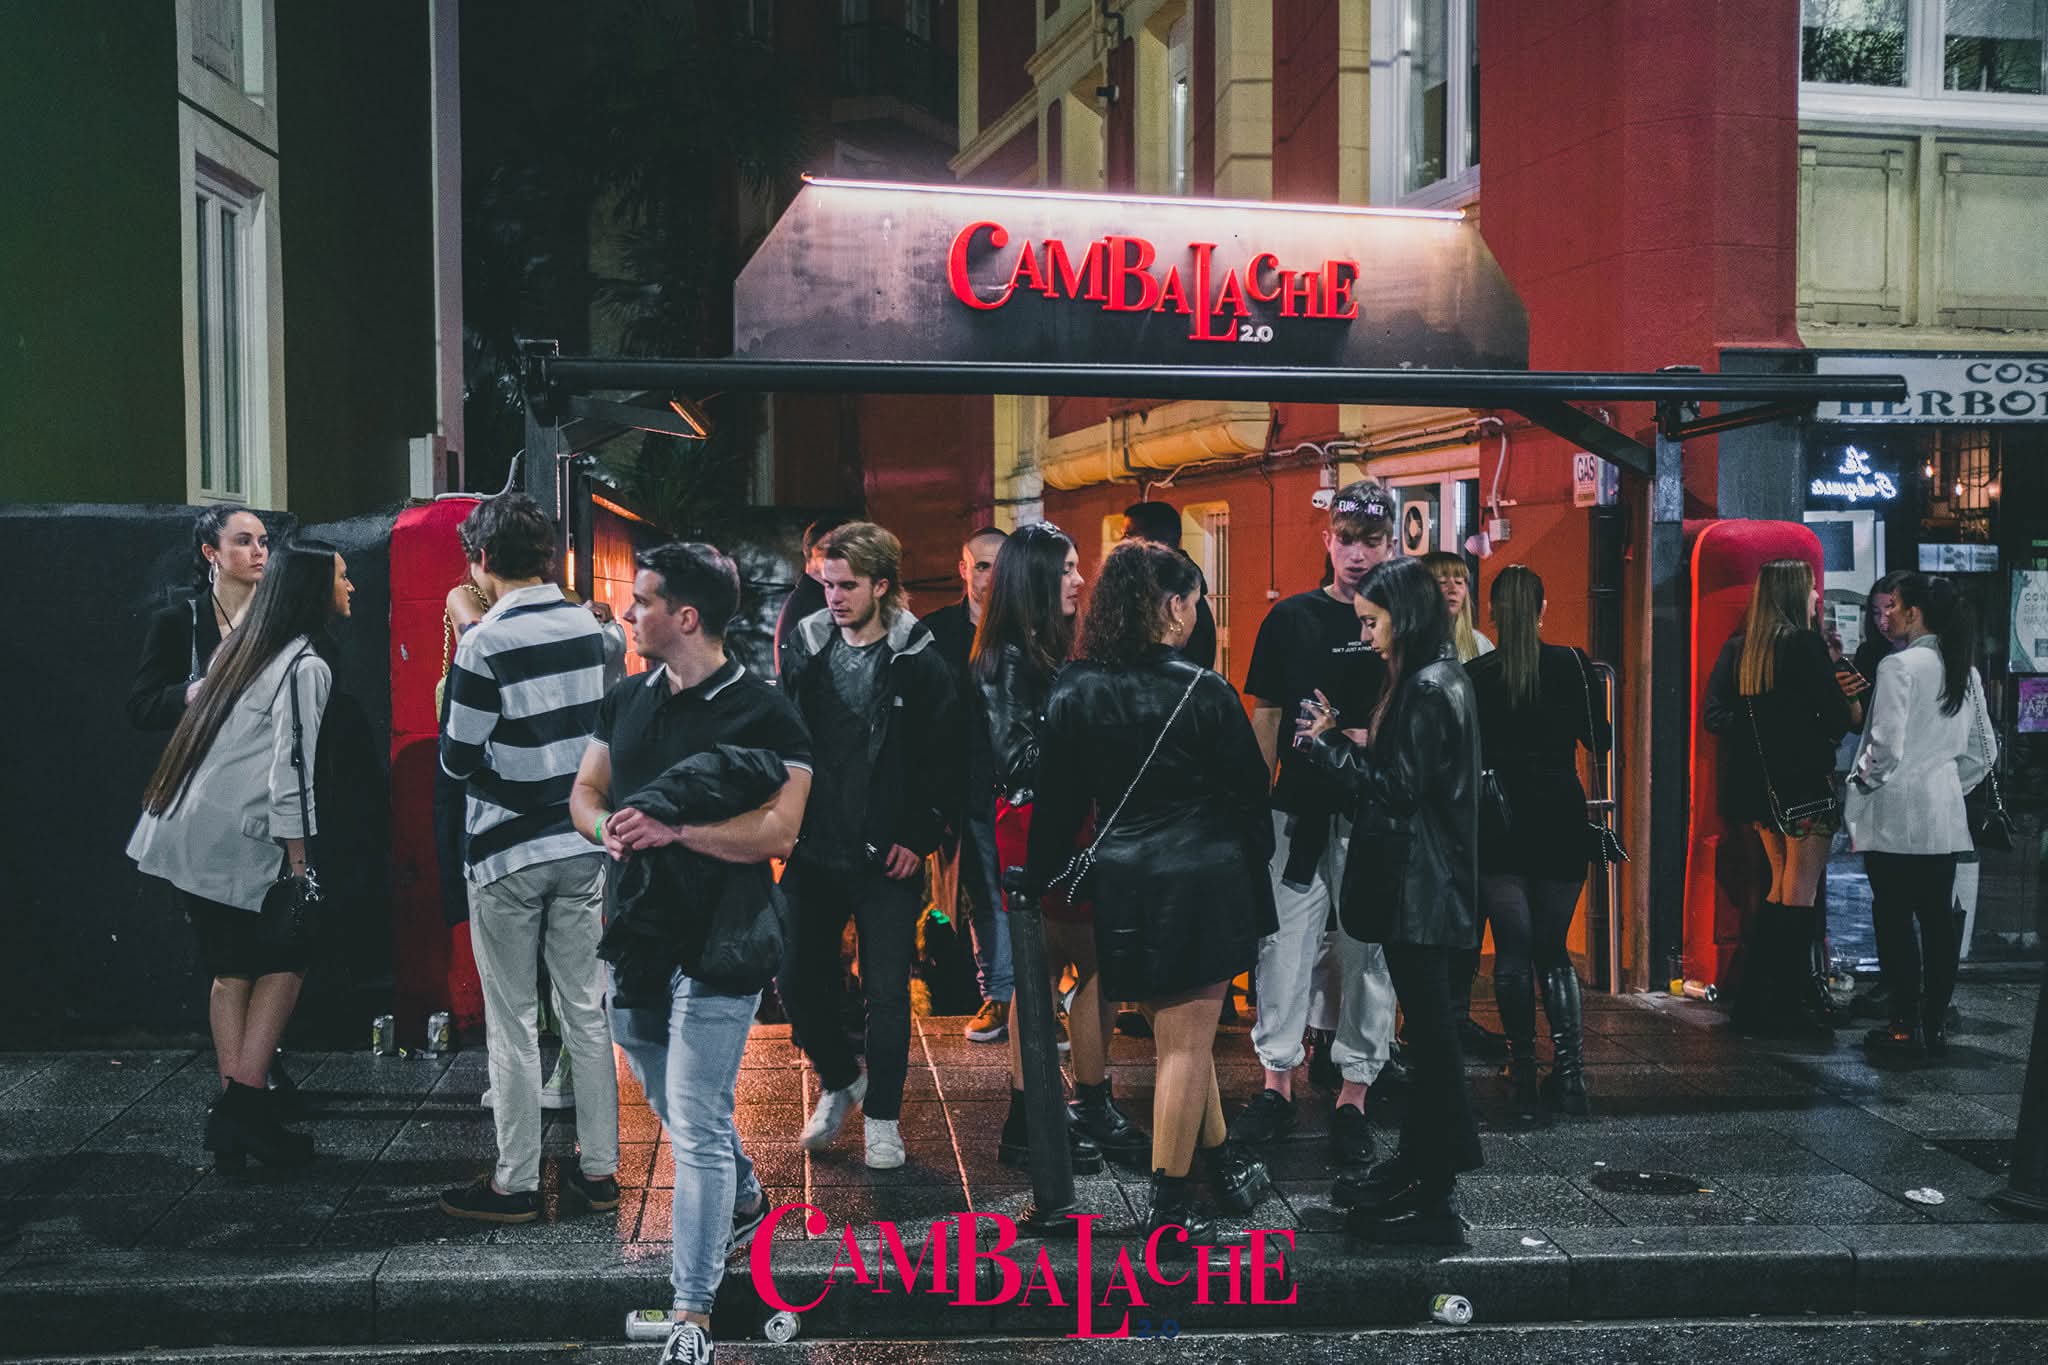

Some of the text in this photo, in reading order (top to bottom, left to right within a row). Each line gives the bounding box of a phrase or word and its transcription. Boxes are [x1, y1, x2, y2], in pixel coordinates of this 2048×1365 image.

[1239, 324, 1274, 342] 2.0
[1838, 390, 2048, 417] HERBO
[1577, 456, 1596, 482] GAS
